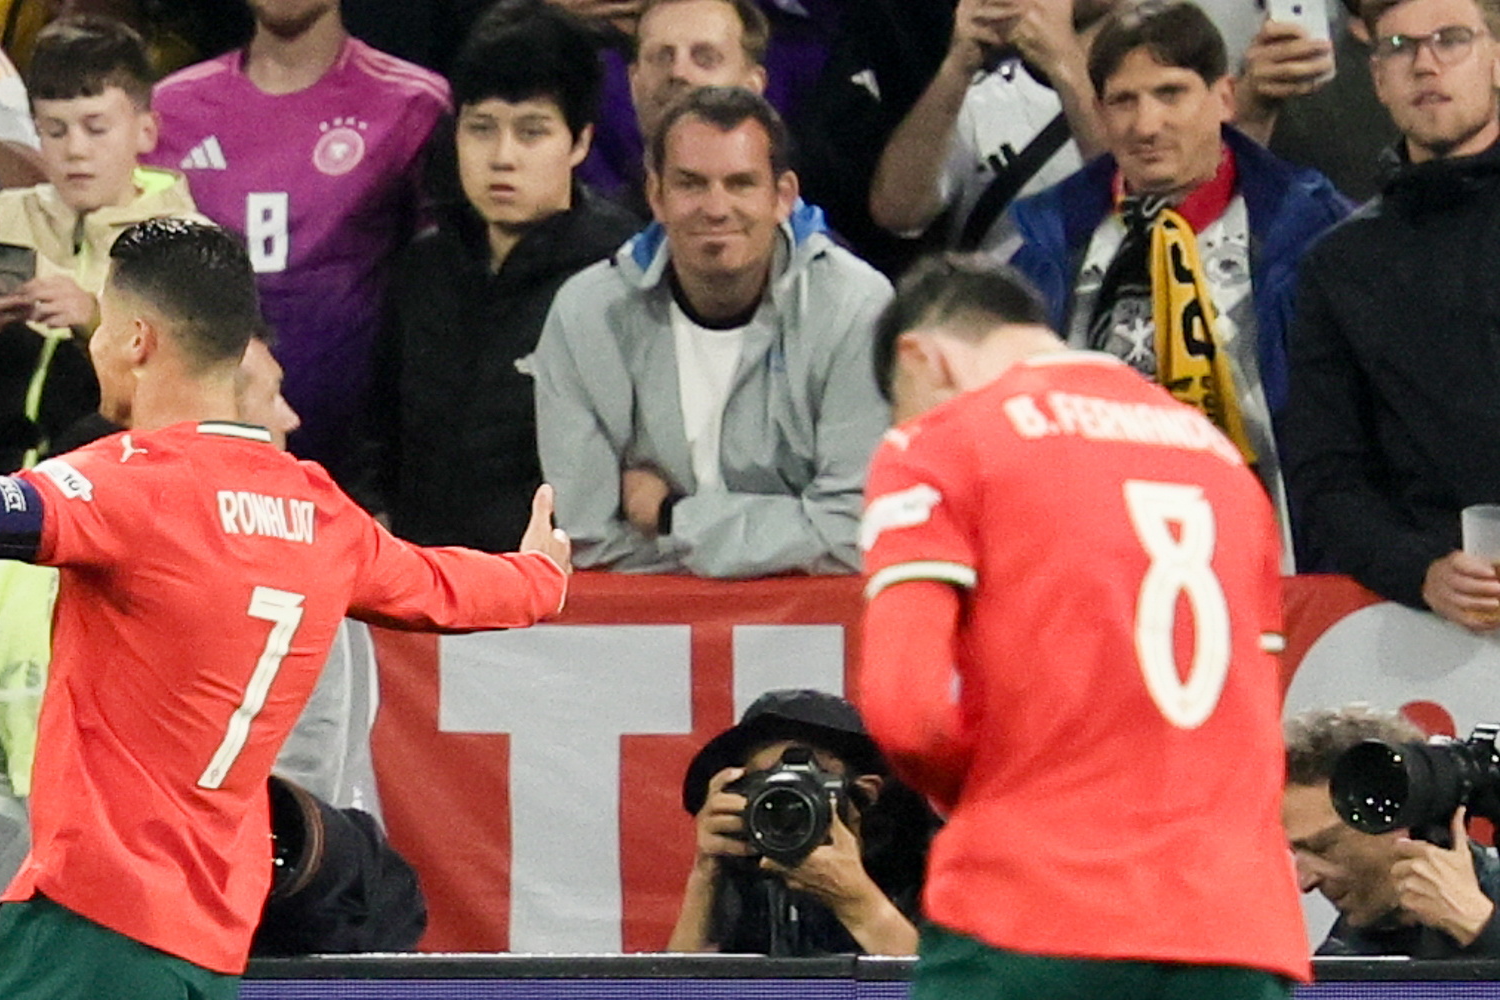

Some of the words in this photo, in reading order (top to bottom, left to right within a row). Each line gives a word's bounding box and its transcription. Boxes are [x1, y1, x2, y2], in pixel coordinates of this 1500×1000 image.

[246, 192, 288, 273] 8
[197, 585, 306, 789] 7
[1122, 479, 1232, 730] 8
